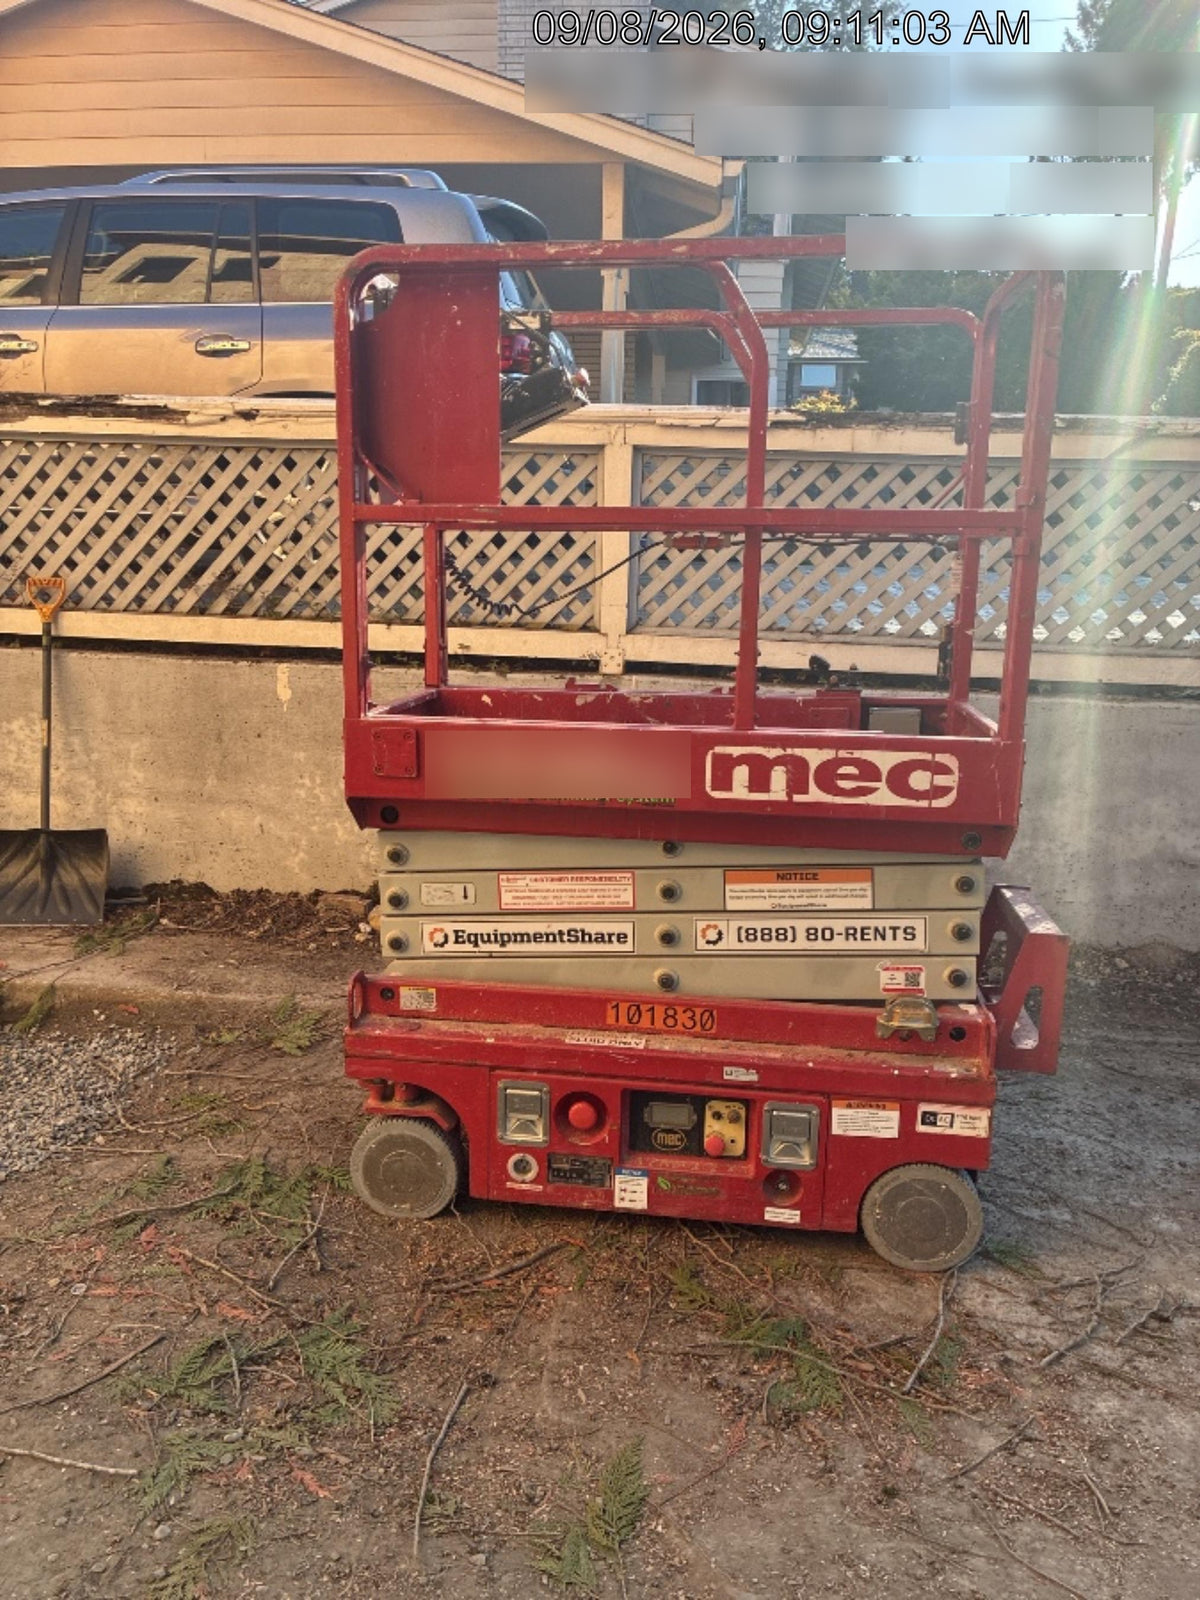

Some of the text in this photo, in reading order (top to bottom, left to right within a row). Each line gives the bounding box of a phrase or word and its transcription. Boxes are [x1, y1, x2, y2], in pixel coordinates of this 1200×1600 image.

[711, 752, 955, 800] mec
[776, 872, 819, 881] NOTICE
[453, 928, 628, 948] EquipmentShare
[737, 926, 917, 942] (888) 80-RENTS
[611, 1002, 715, 1032] 101830
[657, 1133, 682, 1145] mec
